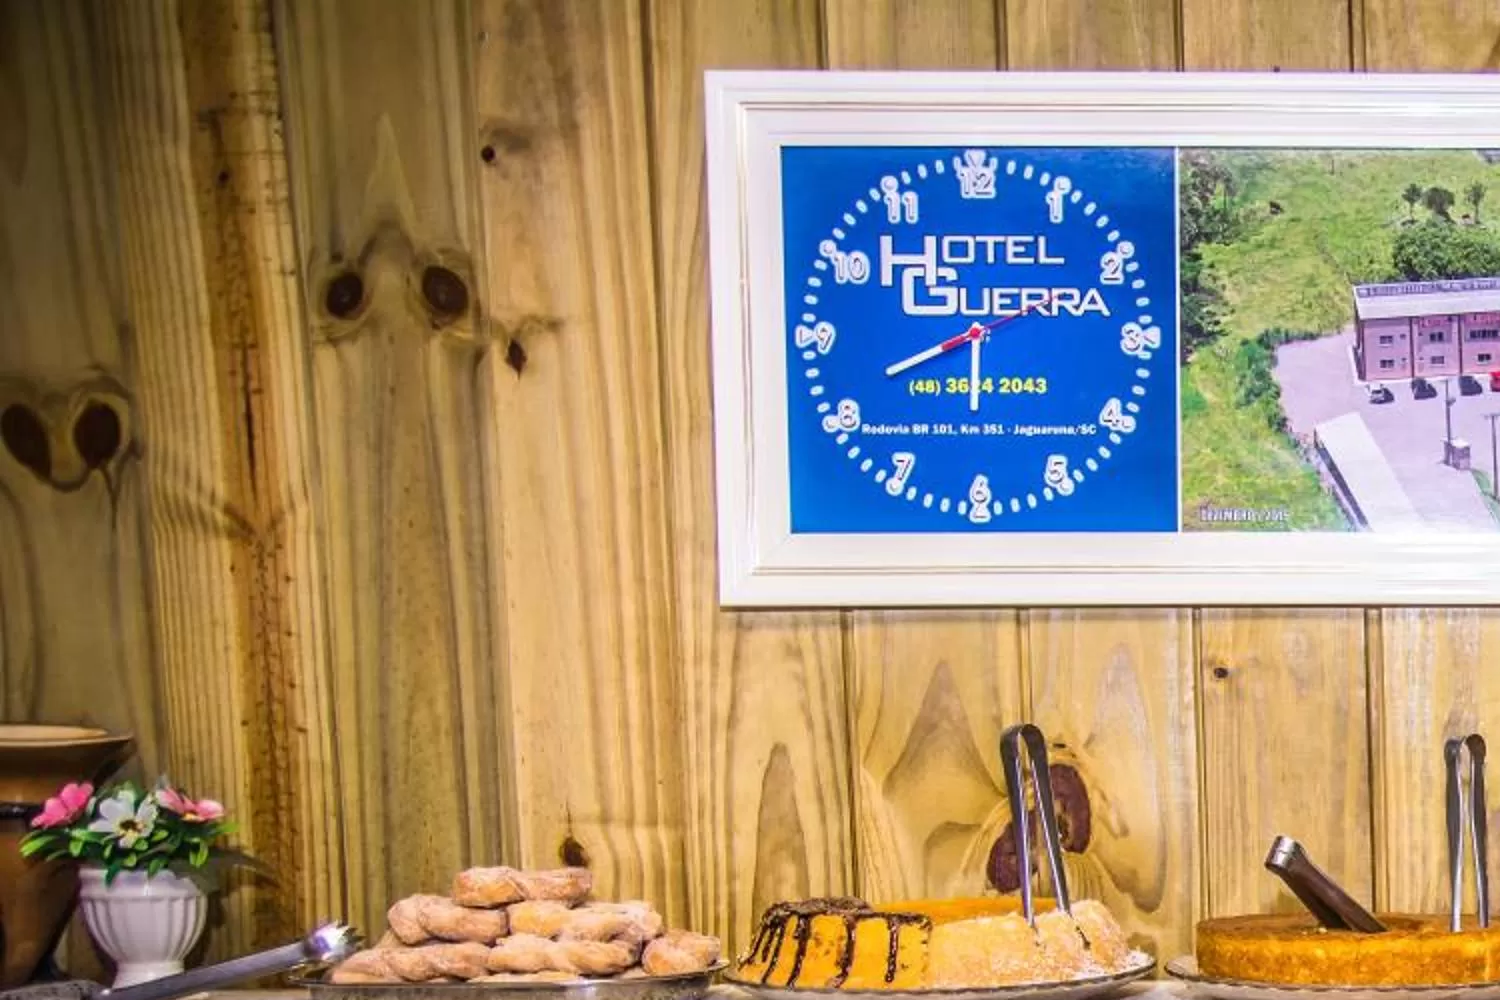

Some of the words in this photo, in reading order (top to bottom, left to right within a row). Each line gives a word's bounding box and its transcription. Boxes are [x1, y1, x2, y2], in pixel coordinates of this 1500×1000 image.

[961, 167, 996, 198] 12
[884, 191, 919, 223] 11
[1046, 191, 1063, 223] 1
[831, 251, 870, 284] 10
[880, 235, 1065, 287] HOTEL
[1100, 251, 1124, 285] 2
[901, 266, 1110, 316] GUERRA
[814, 321, 836, 353] 9
[1120, 322, 1143, 355] 3
[909, 379, 941, 396] (48)
[945, 377, 994, 393] 364
[998, 377, 1047, 393] 2043
[837, 398, 860, 432] 8
[912, 423, 929, 435] BR
[961, 424, 980, 435] Km
[983, 424, 1004, 435] 351
[1099, 398, 1122, 431] 4
[892, 452, 915, 485] 7
[1044, 454, 1068, 487] 5
[970, 474, 991, 504] 6
